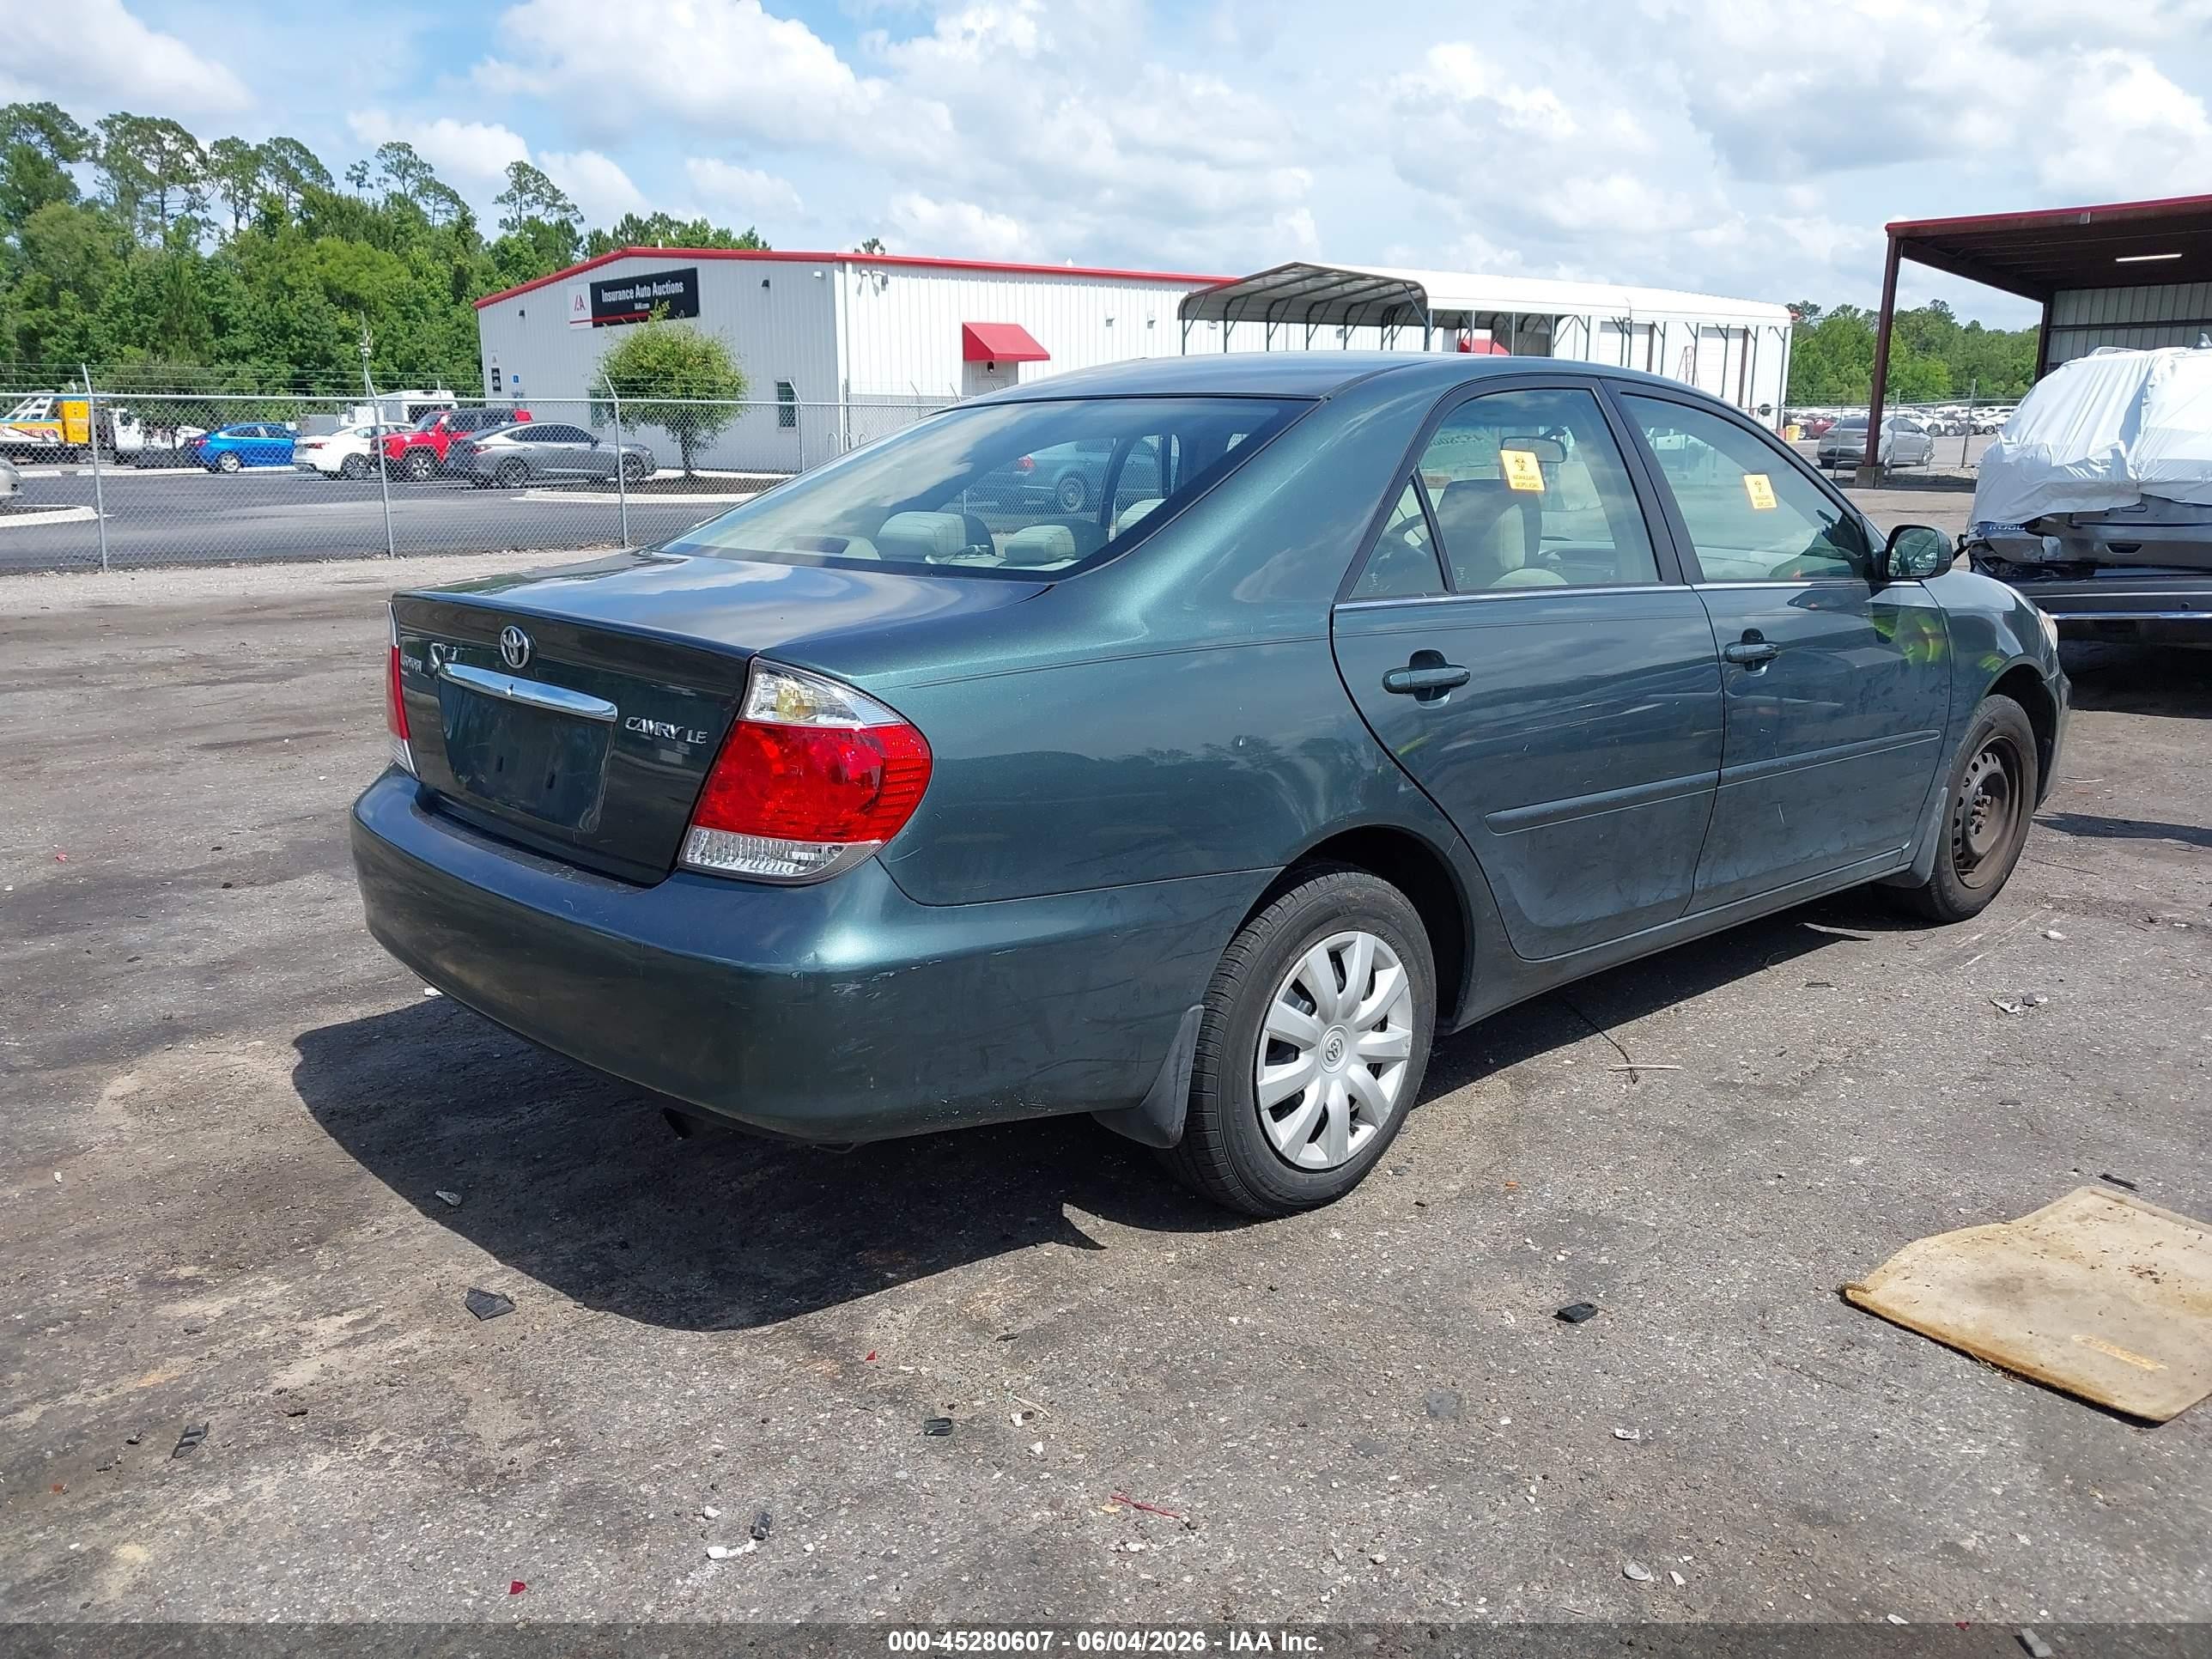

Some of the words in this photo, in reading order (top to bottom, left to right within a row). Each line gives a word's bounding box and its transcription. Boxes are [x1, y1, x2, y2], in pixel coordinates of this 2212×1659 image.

[601, 288, 635, 303] Insurance
[635, 283, 652, 299] Auto
[653, 279, 684, 297] Auctions
[624, 716, 684, 739] CAMRY
[686, 729, 708, 744] LE
